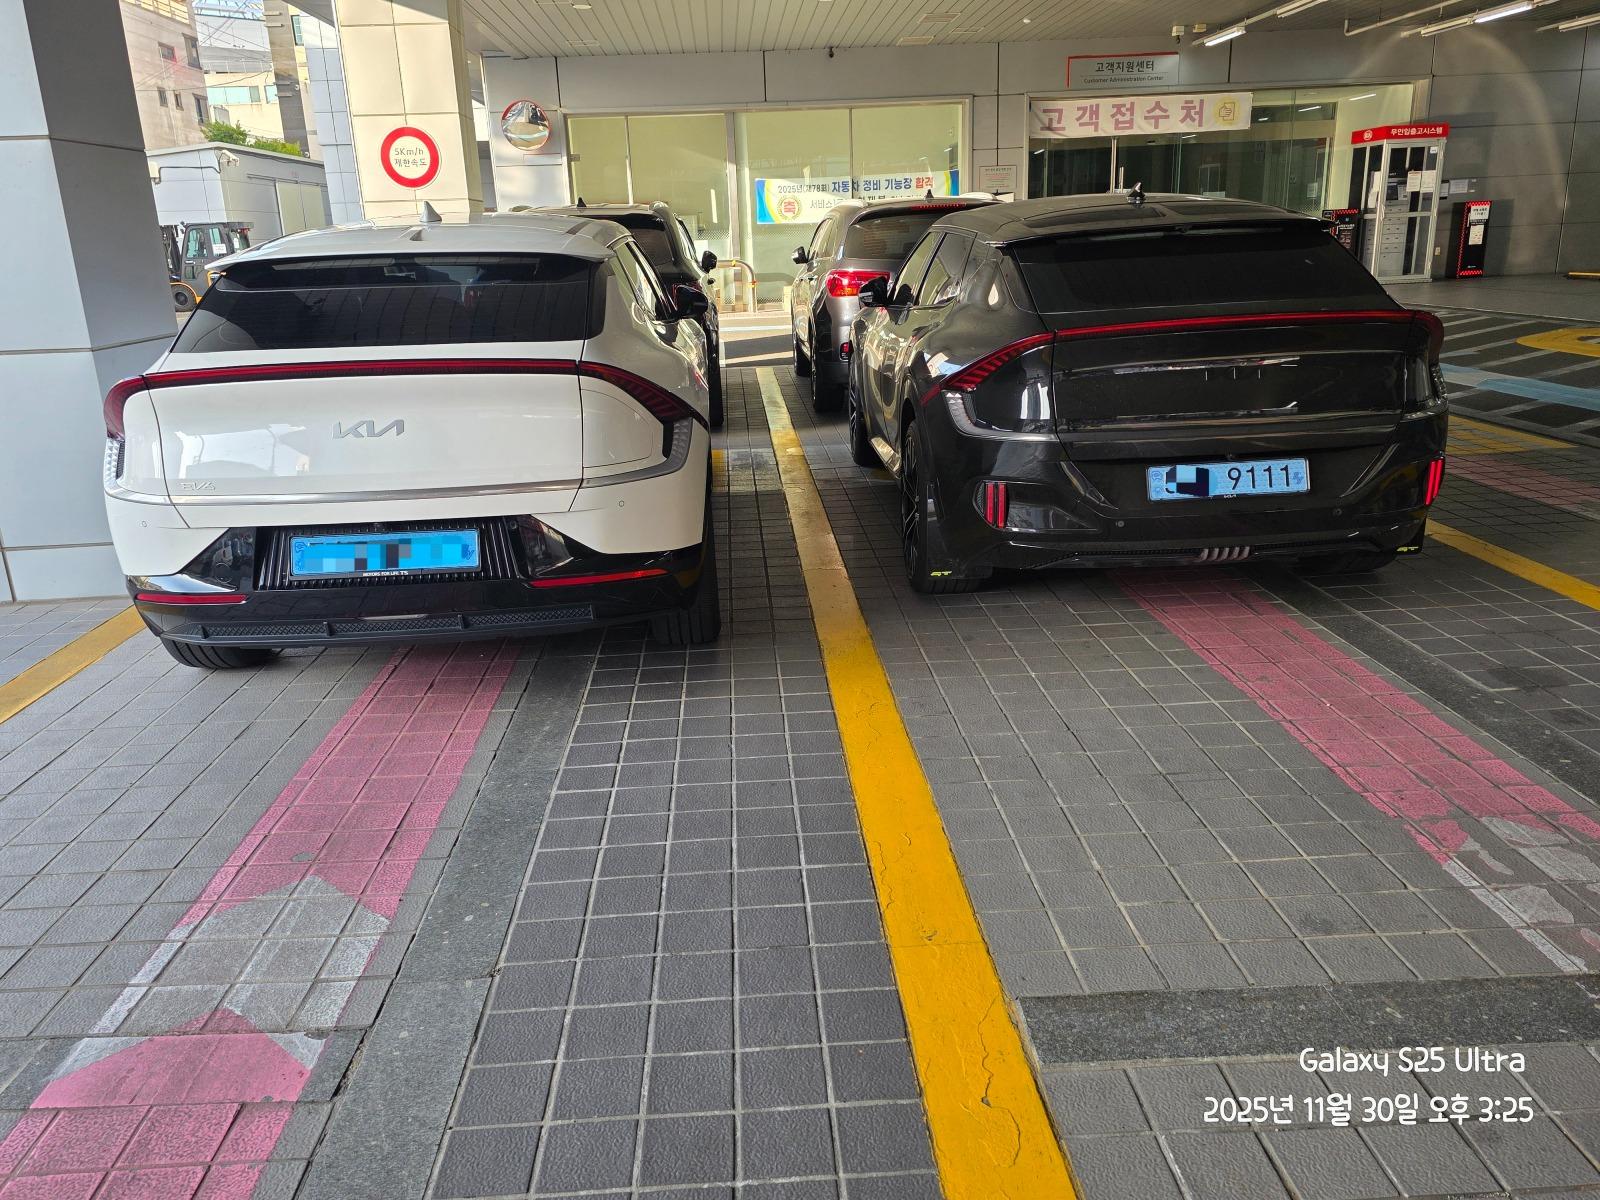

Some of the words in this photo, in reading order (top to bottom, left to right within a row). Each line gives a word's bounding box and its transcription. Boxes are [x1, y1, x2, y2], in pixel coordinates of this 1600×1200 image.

[1096, 60, 1154, 73] 고객지원센터
[1040, 99, 1204, 132] 고객접수처
[394, 158, 428, 168] 제한속도
[831, 180, 860, 193] 자동차
[863, 178, 881, 192] 정비
[884, 177, 912, 190] 기능장
[1227, 464, 1290, 491] 9111
